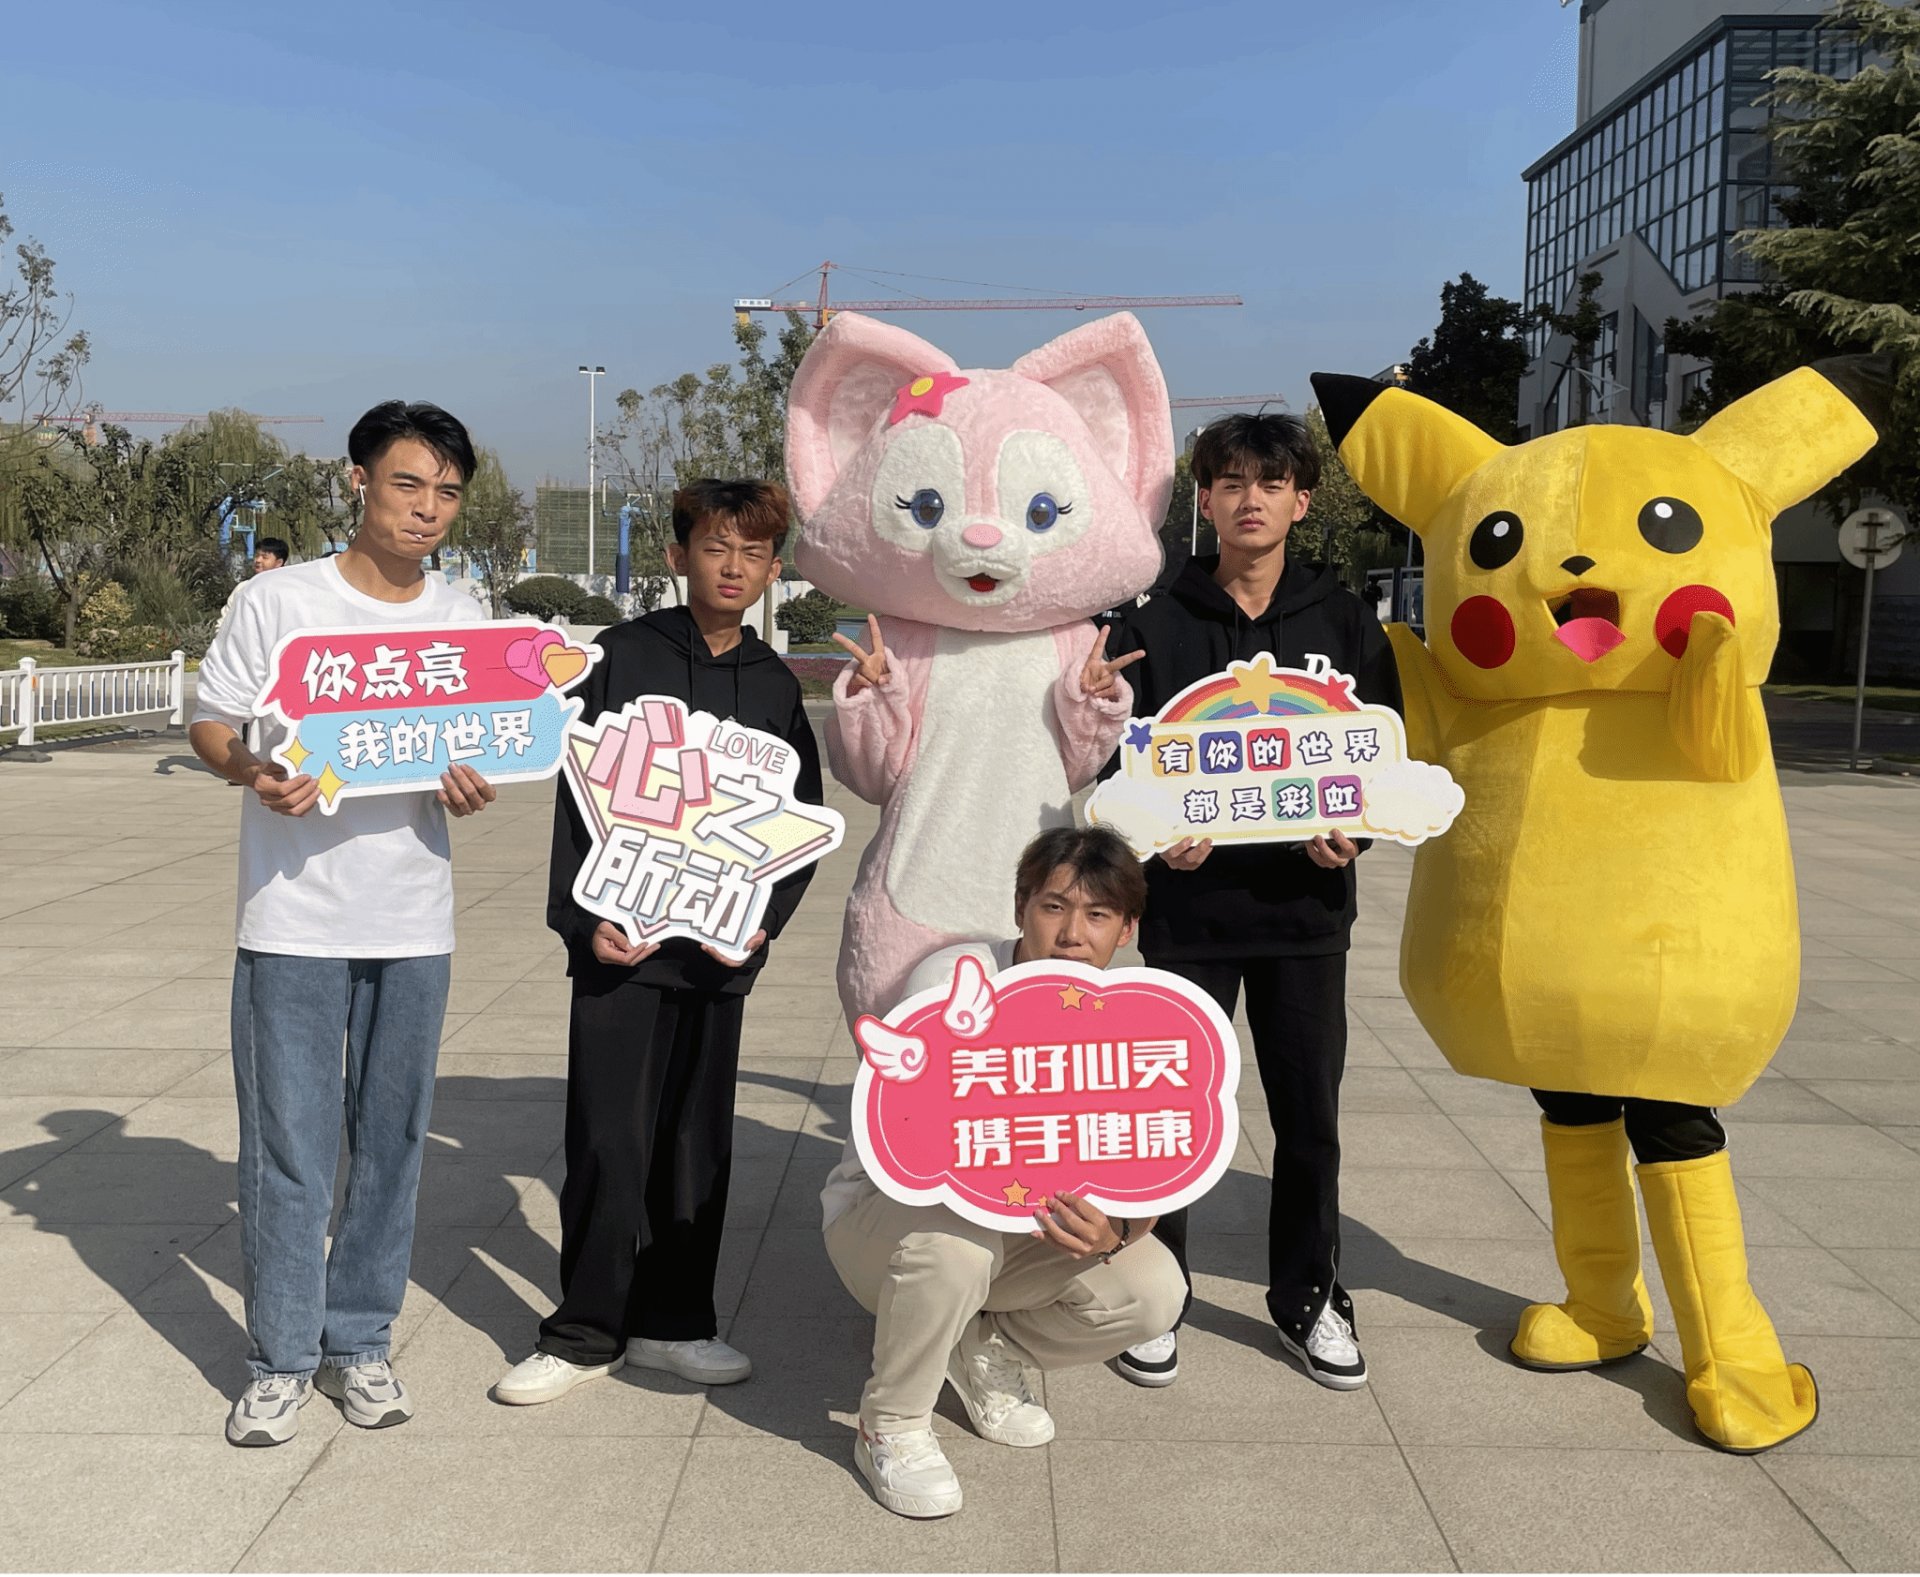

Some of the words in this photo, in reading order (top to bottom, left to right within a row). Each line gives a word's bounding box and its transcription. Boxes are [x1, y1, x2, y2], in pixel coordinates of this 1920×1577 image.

[301, 641, 469, 704] 你点亮
[338, 709, 536, 771] 我的世界
[707, 725, 789, 774] LOVE
[1157, 728, 1380, 774] 有你的世界
[1183, 783, 1359, 824] 都是彩虹
[951, 1039, 1189, 1098] 美好心灵
[953, 1109, 1193, 1168] 携手健康
